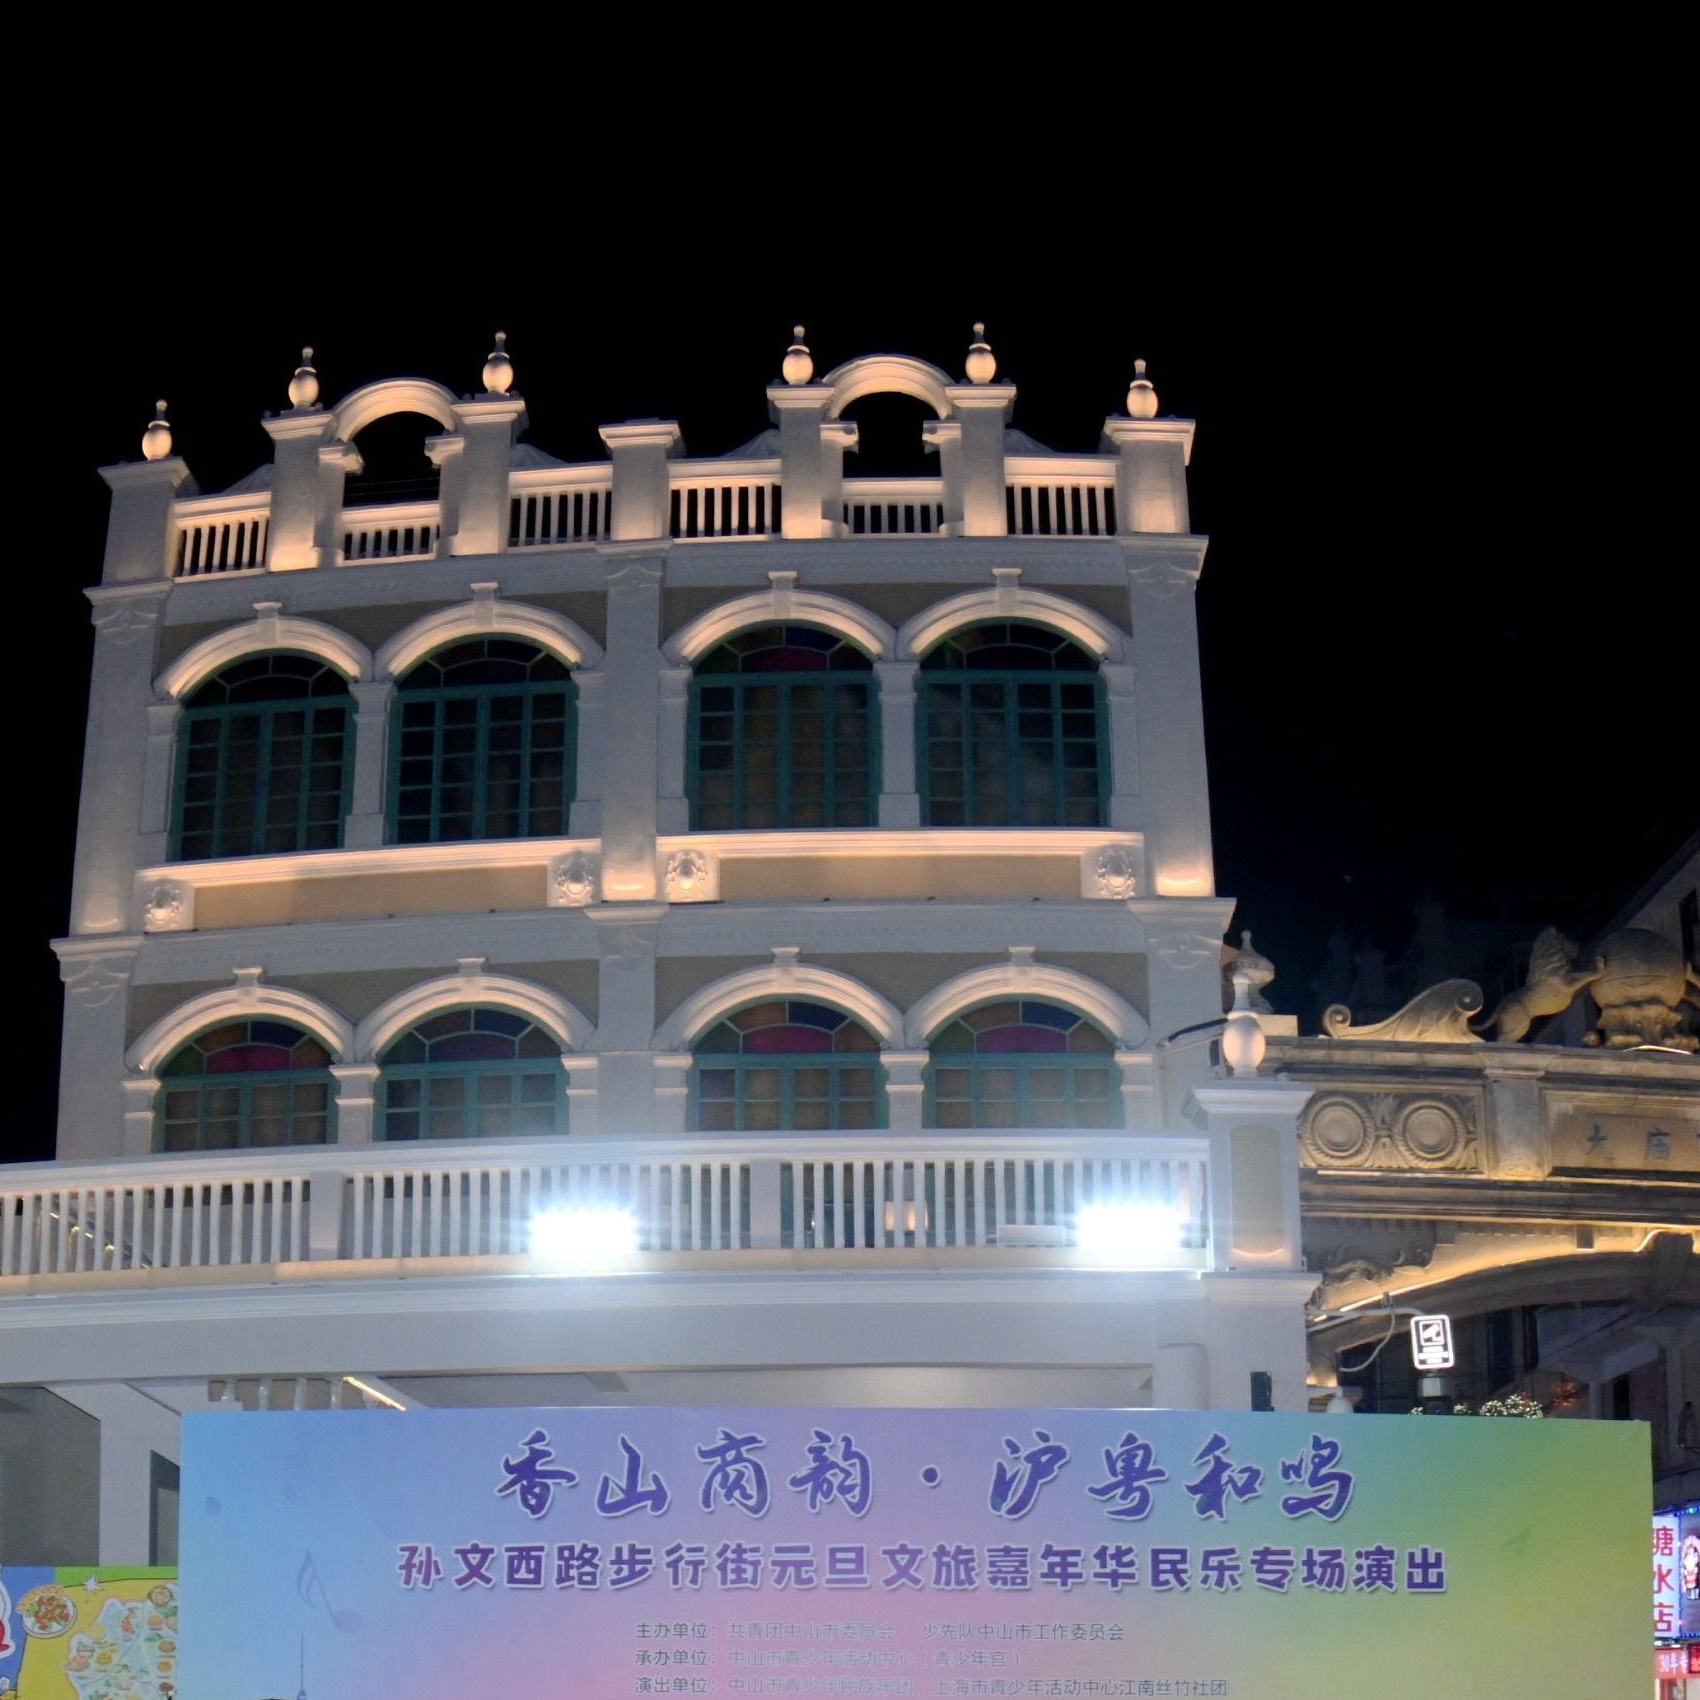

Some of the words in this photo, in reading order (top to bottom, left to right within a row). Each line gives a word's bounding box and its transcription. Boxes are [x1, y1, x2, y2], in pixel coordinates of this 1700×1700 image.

[398, 1542, 1447, 1590] 孙文西路步行街元旦文旅嘉年华民乐专场演出
